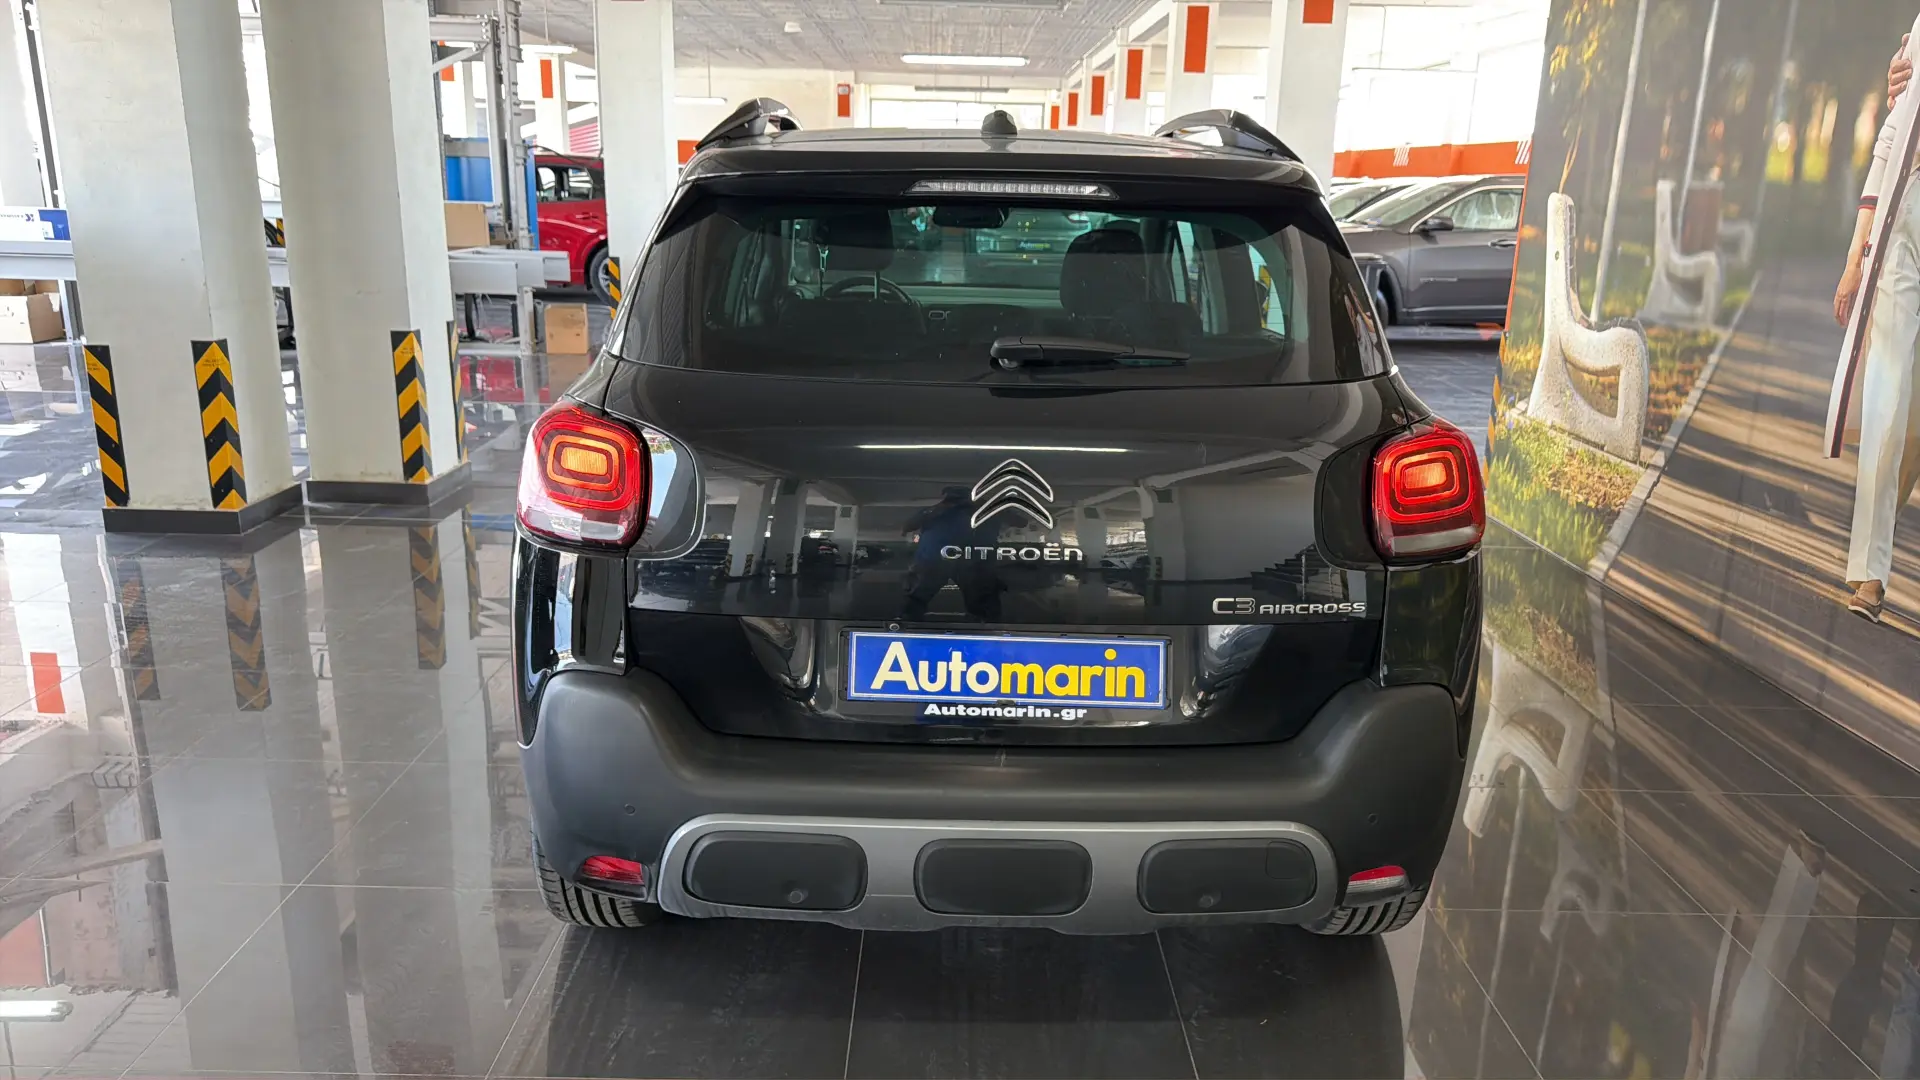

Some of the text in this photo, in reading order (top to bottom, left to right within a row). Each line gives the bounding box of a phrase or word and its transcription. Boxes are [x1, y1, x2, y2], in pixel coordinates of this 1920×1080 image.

[1212, 597, 1367, 615] C3 AIRCROSS
[870, 641, 1145, 698] Automarin
[923, 703, 1088, 721] Automarin.gr
